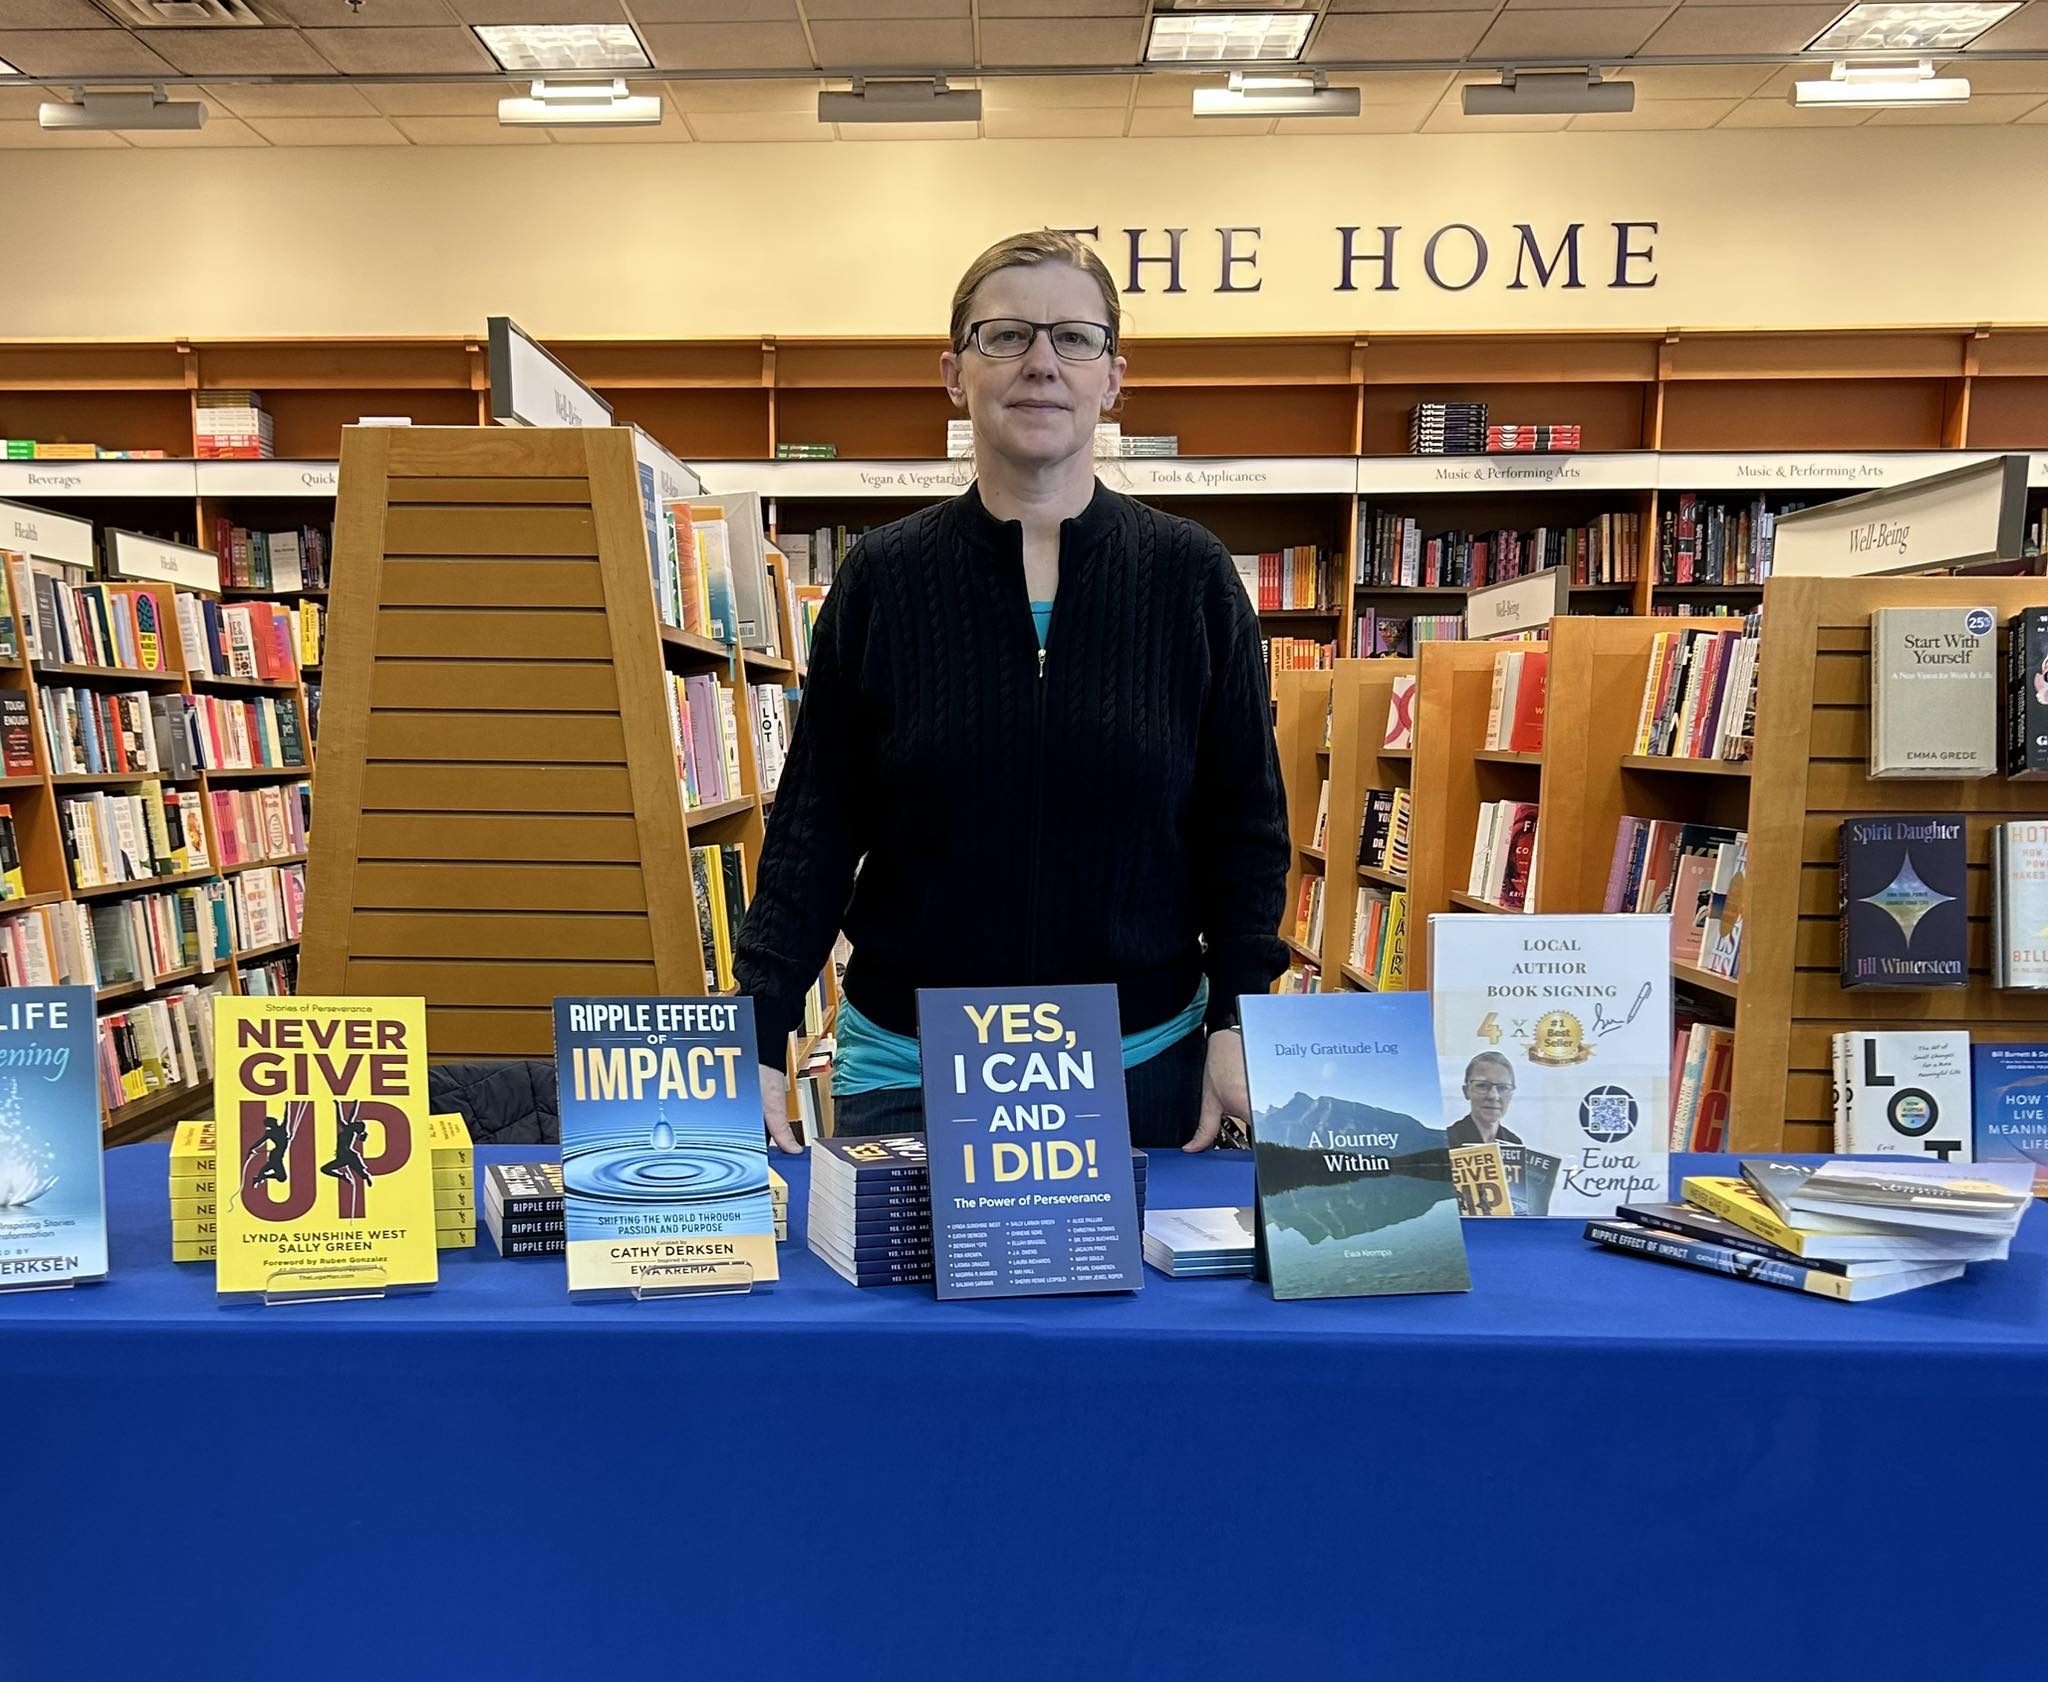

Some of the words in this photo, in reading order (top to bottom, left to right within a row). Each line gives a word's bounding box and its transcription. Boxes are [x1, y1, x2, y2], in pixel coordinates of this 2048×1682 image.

[1332, 222, 1659, 292] HOME
[301, 472, 336, 486] Quick
[860, 472, 894, 488] Vegan
[897, 474, 908, 486] &
[1149, 470, 1182, 482] Tools
[1185, 472, 1196, 483] &
[1198, 470, 1267, 487] Applicances
[1435, 468, 1471, 480] Music
[1474, 469, 1486, 480] &
[1487, 467, 1553, 482] Performing
[1554, 467, 1580, 479] Arts
[1736, 465, 1772, 477] Music
[1775, 466, 1787, 477] &
[1789, 465, 1857, 480] Performing
[1858, 465, 1884, 476] Arts
[27, 473, 82, 489] Beverages
[14, 521, 38, 541] Health
[1849, 521, 1911, 554] Well-Being
[1904, 634, 1941, 649] Start
[1943, 634, 1980, 649] With
[1913, 650, 1973, 664] Yourself
[1907, 752, 1937, 760] EMMA
[1940, 751, 1977, 760] GREDE
[1853, 823, 1892, 845] Spirit
[1896, 820, 1960, 843] Daughter
[1523, 939, 1581, 951] LOCAL
[1511, 962, 1587, 974] AUTHOR
[1855, 957, 1877, 978] Jill
[1880, 955, 1961, 975] Wintersteen
[1487, 985, 1538, 998] BOOK
[1542, 984, 1617, 998] SIGNING
[265, 1003, 296, 1013] Stories
[298, 1003, 309, 1012] of
[311, 1003, 373, 1014] Perseverance
[570, 1004, 651, 1033] RIPPLE
[657, 1004, 738, 1032] EFFECT
[963, 1003, 1077, 1049] YES,
[1550, 1019, 1566, 1028] #1
[237, 1018, 407, 1049] NEVER
[1476, 1011, 1503, 1044] 4
[1547, 1029, 1571, 1037] Best
[647, 1034, 667, 1045] OF
[1543, 1038, 1573, 1048] Seller
[1274, 1043, 1307, 1058] Daily
[1310, 1042, 1372, 1055] Gratitude
[1374, 1042, 1399, 1056] Log
[238, 1053, 410, 1096] GIVE
[572, 1047, 742, 1101] IMPACT
[953, 1054, 967, 1094] I
[981, 1051, 1095, 1093] CAN
[2005, 1094, 2041, 1105] HOW
[988, 1104, 1066, 1133] AND
[2013, 1110, 2044, 1120] LIVE
[1307, 1131, 1322, 1148] A
[1328, 1130, 1399, 1154] Journey
[239, 1100, 412, 1222] UP
[963, 1144, 976, 1184] I
[992, 1139, 1099, 1183] DID!
[1323, 1152, 1390, 1173] Within
[1581, 1147, 1640, 1170] Ewa
[1562, 1168, 1660, 1204] Krempa
[513, 1202, 543, 1212] RIPPLE
[954, 1198, 977, 1209] The
[979, 1196, 1016, 1208] Power
[1018, 1194, 1032, 1206] of
[1033, 1191, 1112, 1205] Perseverance
[598, 1215, 640, 1226] SHIFTING
[643, 1214, 661, 1223] THE
[663, 1213, 695, 1223] WORLD
[698, 1212, 741, 1222] THROUGH
[512, 1222, 542, 1233] RIPPLE
[618, 1225, 657, 1235] PASSION
[660, 1224, 679, 1234] AND
[681, 1223, 723, 1233] PURPOSE
[242, 1233, 288, 1243] LYNDA
[294, 1231, 363, 1242] SUNSHINE
[368, 1229, 407, 1240] WEST
[1591, 1229, 1618, 1244] RIPPLE
[1618, 1235, 1646, 1250] EFFECT
[1647, 1240, 1658, 1252] OF
[1659, 1243, 1689, 1258] IMPACT
[278, 1243, 321, 1253] SALLY
[325, 1241, 373, 1252] GREEN
[513, 1242, 543, 1252] RIPPLE
[610, 1246, 659, 1258] CATHY
[666, 1244, 734, 1256] DERKSEN
[263, 1258, 304, 1267] Foreword
[306, 1258, 317, 1266] by
[319, 1257, 347, 1265] Ruben
[349, 1256, 388, 1264] Gonzalez
